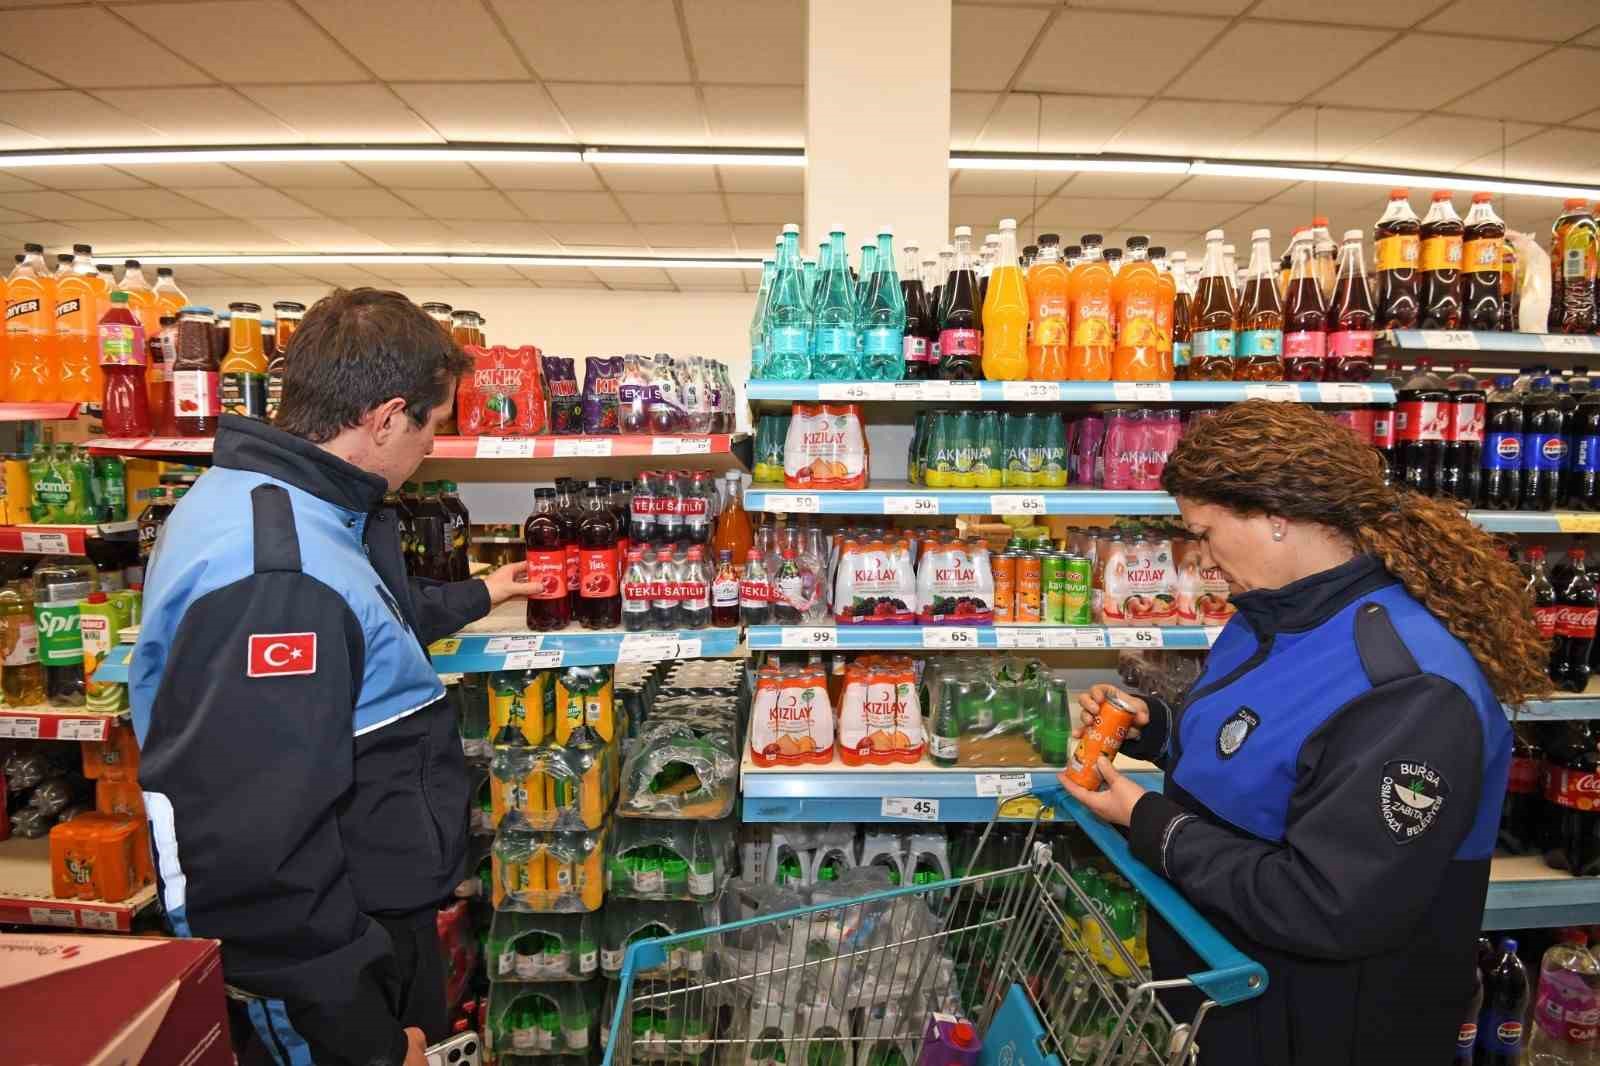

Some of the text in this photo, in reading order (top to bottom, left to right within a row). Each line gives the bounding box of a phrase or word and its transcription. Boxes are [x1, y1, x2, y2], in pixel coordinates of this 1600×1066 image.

[803, 432, 845, 444] KIZILAY
[1022, 499, 1038, 509] 65
[813, 632, 829, 641] 99
[951, 632, 967, 641] 65
[1136, 632, 1152, 641] 65
[769, 705, 813, 720] KIZILAY
[863, 702, 908, 715] KIZILAY
[1400, 763, 1440, 788] BURSA
[914, 802, 931, 813] 45
